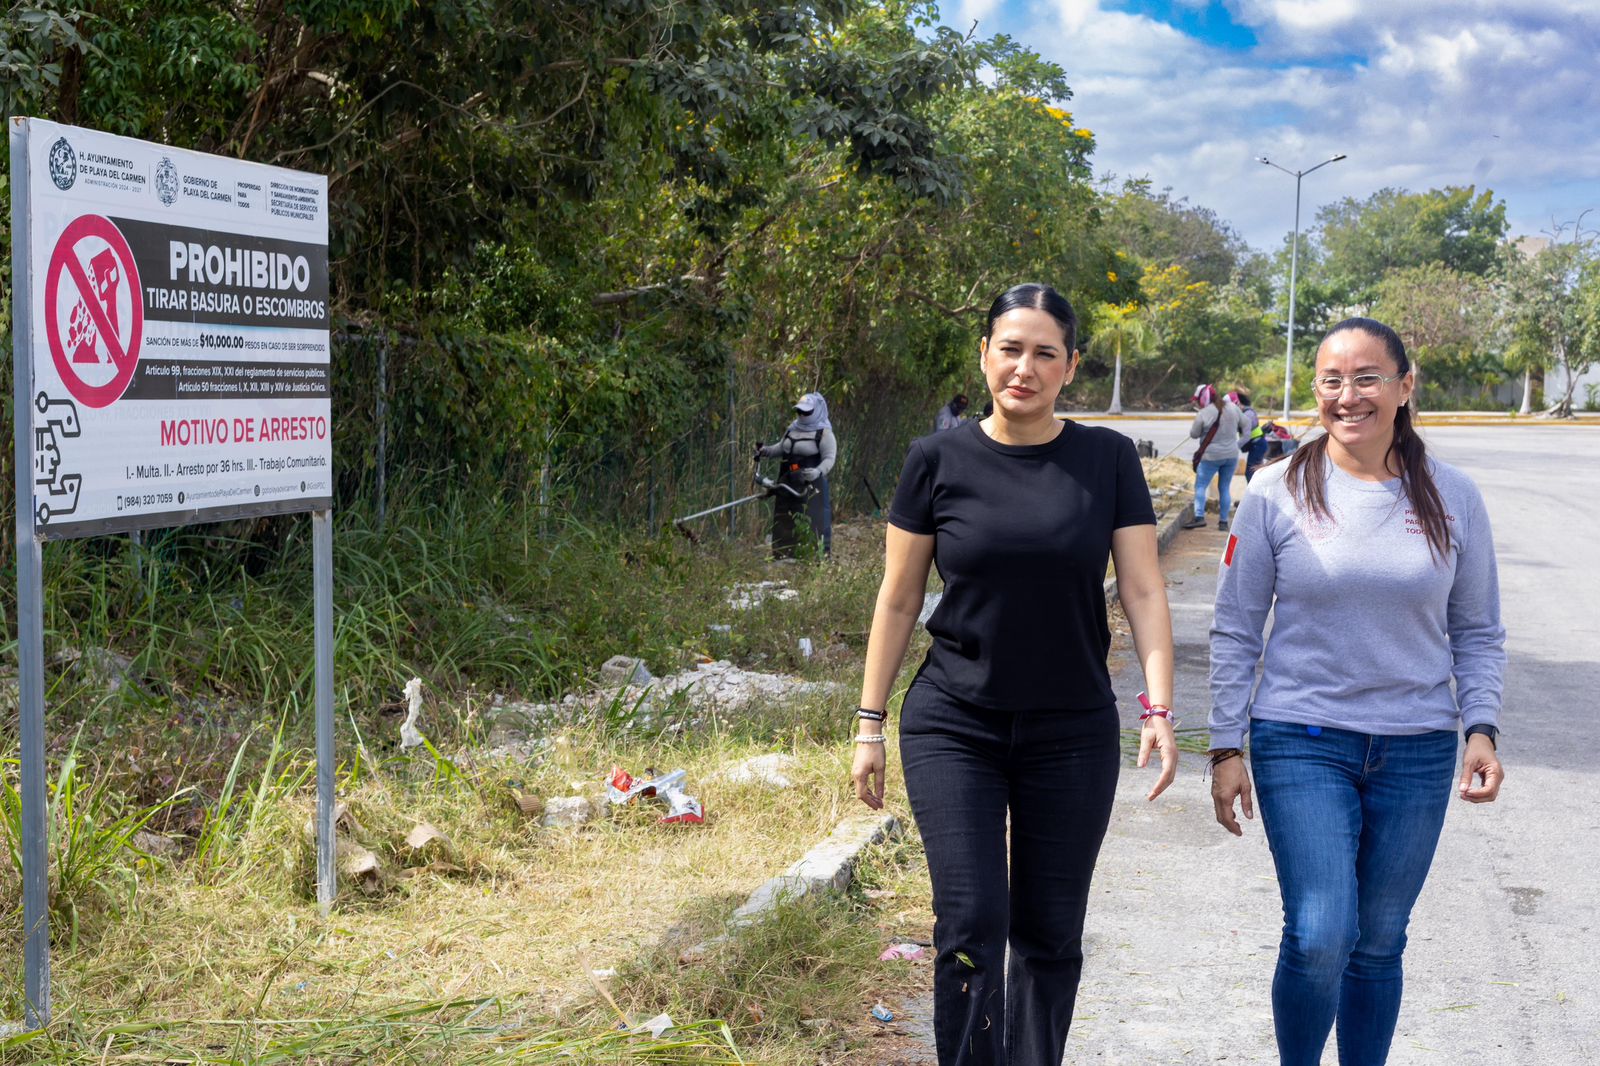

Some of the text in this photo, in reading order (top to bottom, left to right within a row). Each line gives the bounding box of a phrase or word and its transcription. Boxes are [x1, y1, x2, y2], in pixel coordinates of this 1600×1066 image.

[80, 152, 133, 170] H. AYUNTAMIENTO
[80, 165, 146, 184] DE PLAYA DEL CARMEN
[183, 175, 218, 189] GOBIERNO DE
[183, 187, 232, 203] PLAYA DEL CARMEN
[169, 240, 310, 293] PROHIBIDO
[147, 287, 325, 320] TIRAR BASURA O ESCOMBROS
[146, 332, 325, 352] SANCIÓN DE MÁS DE $10,000.00 PESOS EN CASO DE SER SORPRENDIDO
[171, 365, 182, 376] 99,
[183, 365, 211, 376] fracciones
[211, 366, 224, 377] XIX,
[224, 366, 234, 376] XXI
[234, 367, 244, 376] del
[245, 367, 275, 379] reglamento
[276, 367, 283, 377] de
[283, 368, 305, 377] servicios
[305, 368, 326, 379] públicos.
[201, 382, 209, 392] 50
[209, 382, 238, 392] fracciones
[270, 384, 275, 394] y
[285, 382, 292, 392] de
[292, 382, 310, 392] Justicia
[160, 416, 326, 447] MOTIVO DE ARRESTO
[126, 466, 135, 480] I.-
[136, 464, 162, 479] Multa.
[164, 463, 174, 477] II.-
[176, 462, 204, 477] Arresto
[206, 463, 218, 477] por
[220, 460, 230, 472] 36
[231, 459, 245, 472] hrs.
[259, 457, 286, 472] Trabajo
[286, 455, 327, 468] Comunitario.
[124, 495, 141, 508] (984)
[143, 494, 155, 505] 320
[156, 493, 173, 504] 7059
